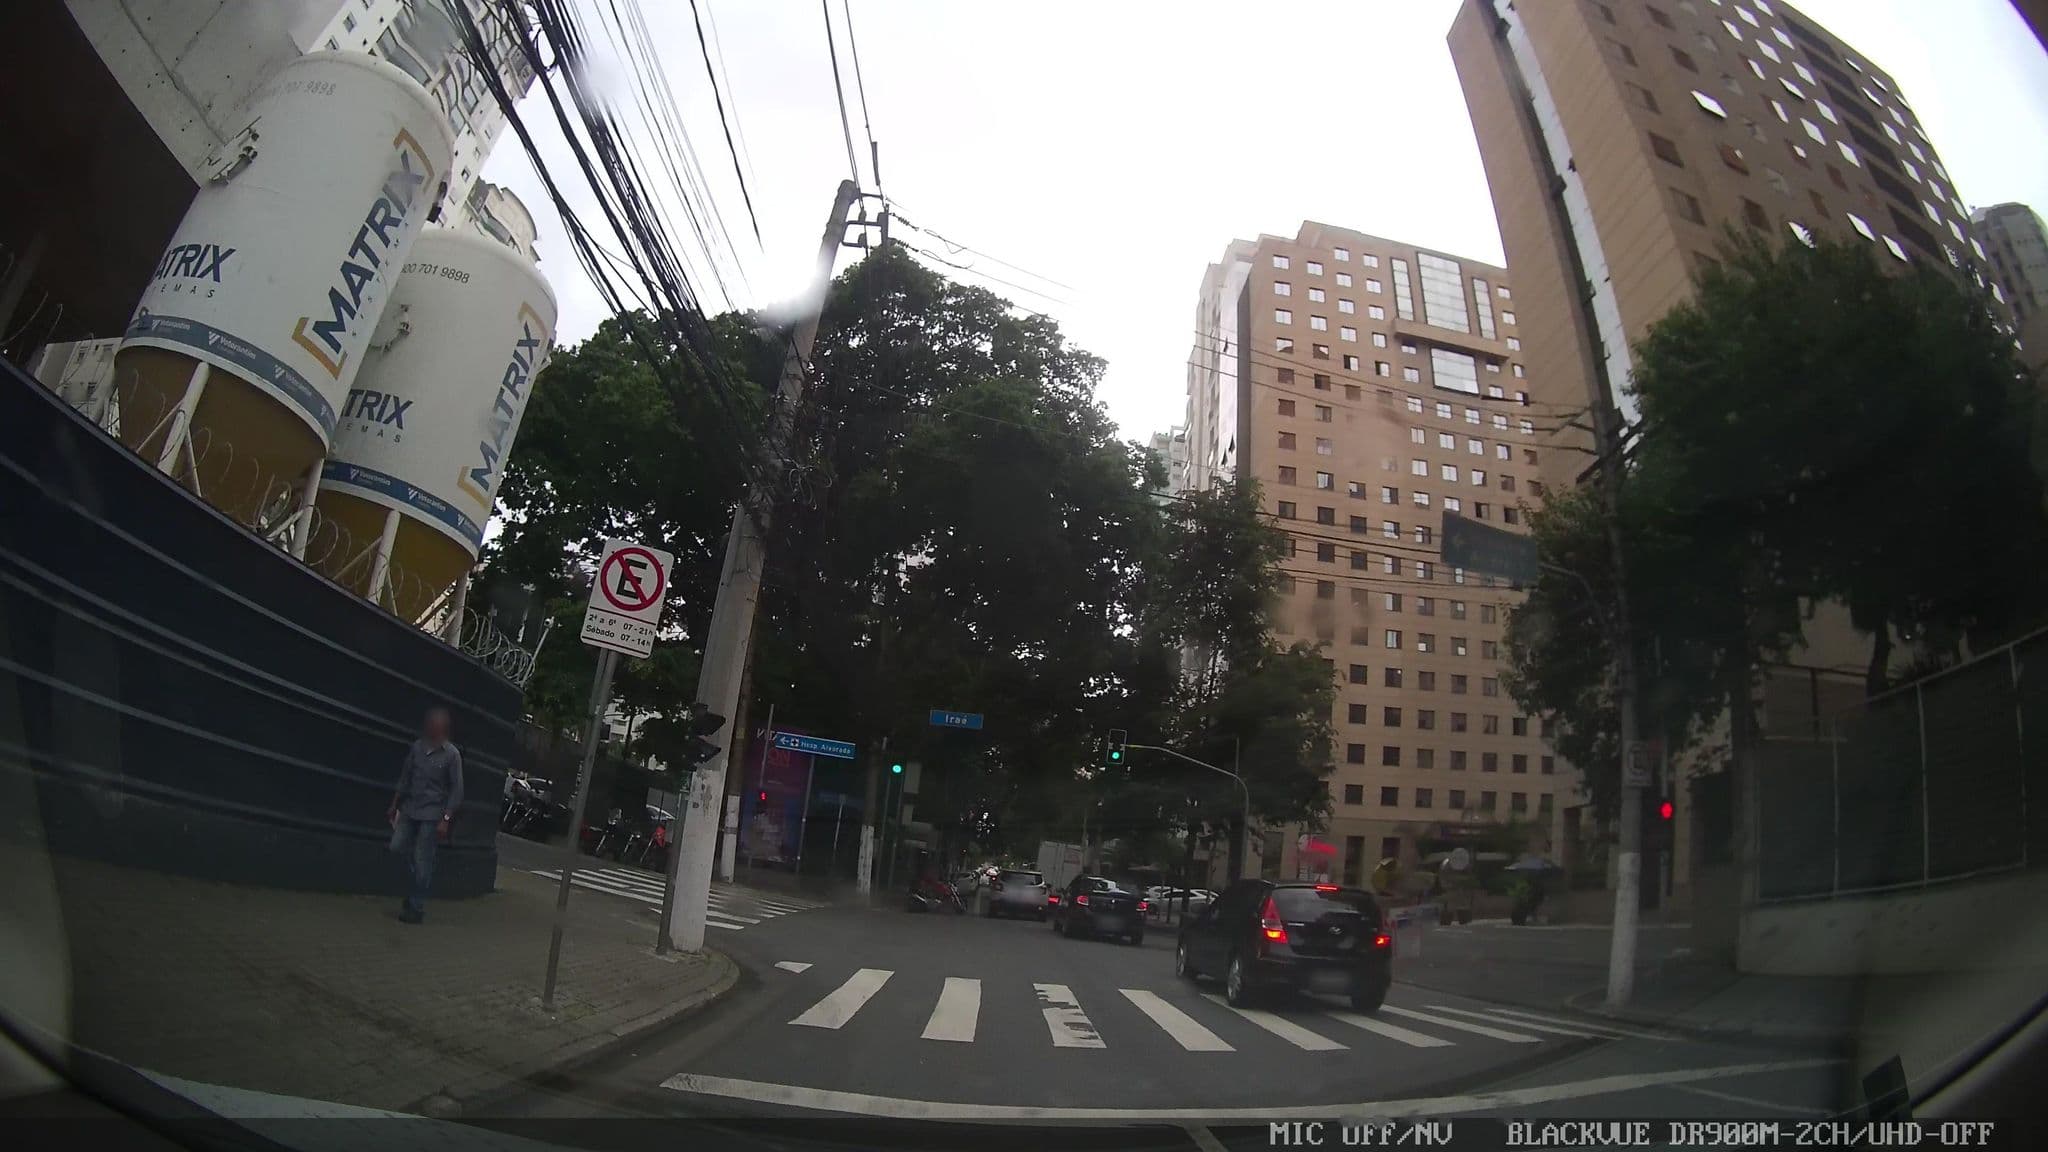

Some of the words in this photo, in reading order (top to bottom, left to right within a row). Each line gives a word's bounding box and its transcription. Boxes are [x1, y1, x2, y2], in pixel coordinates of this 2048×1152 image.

[312, 149, 425, 355] MATRIX
[418, 263, 438, 275] 701
[439, 266, 470, 284] 9898
[470, 320, 541, 492] MATRIX
[616, 558, 649, 600] E
